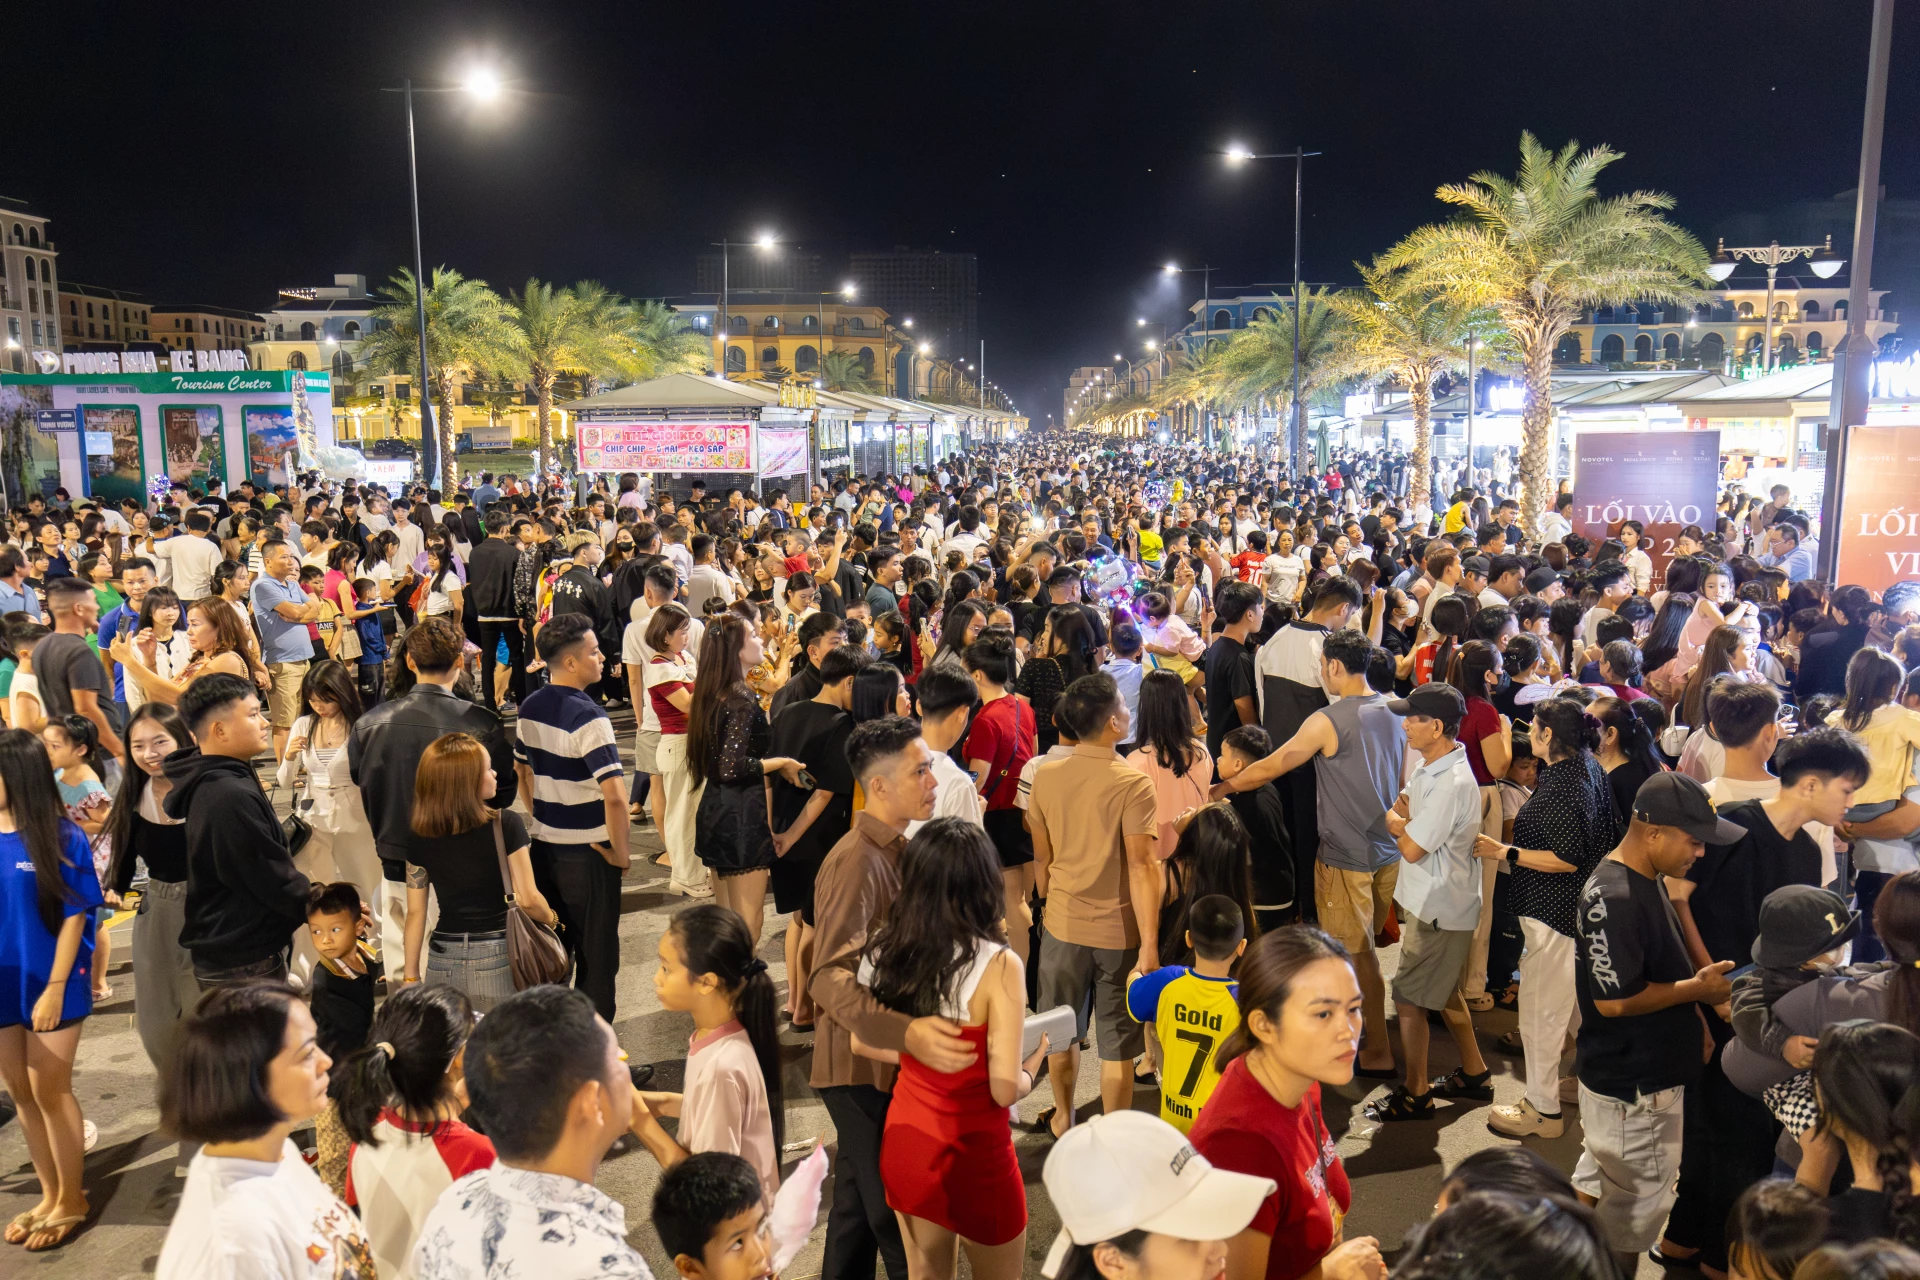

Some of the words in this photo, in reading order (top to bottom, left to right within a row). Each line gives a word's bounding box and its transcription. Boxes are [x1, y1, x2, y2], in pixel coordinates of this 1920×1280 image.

[62, 352, 119, 374] PHONG
[121, 351, 158, 373] NHA
[170, 350, 195, 372] KE
[196, 349, 244, 372] BANG
[171, 375, 225, 390] Tourism
[227, 375, 272, 391] Center
[624, 427, 649, 441] THẾ
[679, 430, 704, 443] KẸO
[605, 444, 624, 453] CHIP
[626, 444, 646, 453] CHIP
[664, 445, 678, 453] MAI
[1585, 499, 1635, 524] LỐI
[1640, 500, 1702, 524] VÀO
[1858, 506, 1919, 537] LỐI
[1174, 1003, 1223, 1032] Gold
[1176, 1028, 1216, 1100] 7
